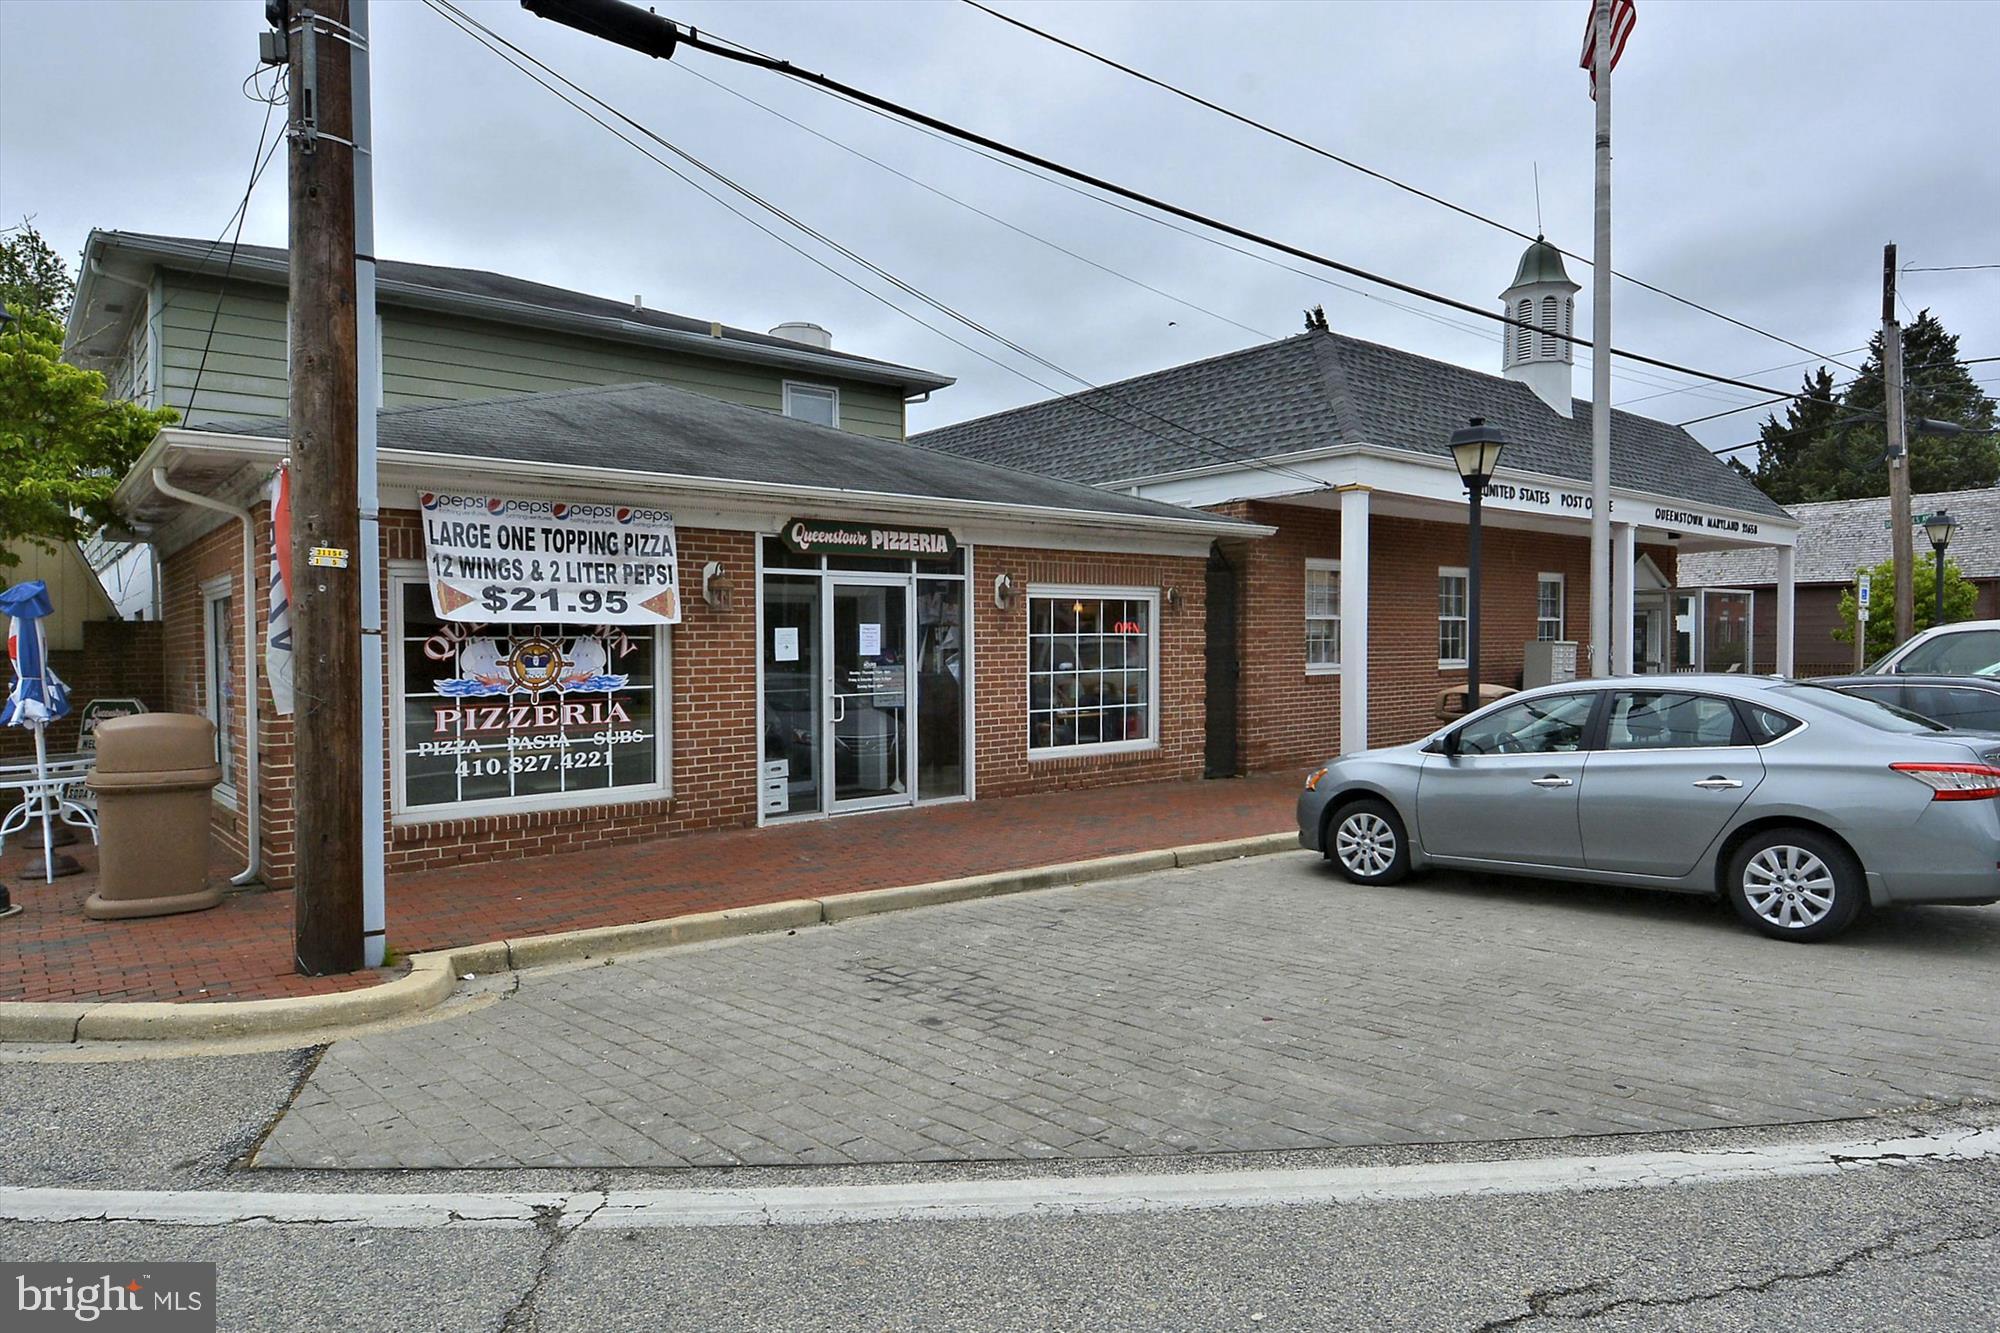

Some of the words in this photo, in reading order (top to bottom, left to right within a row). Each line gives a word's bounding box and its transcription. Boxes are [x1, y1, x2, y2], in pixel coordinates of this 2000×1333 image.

[439, 494, 487, 510] pepsi
[506, 499, 553, 514] pepsi
[1483, 482, 1516, 499] UNITED
[1519, 487, 1551, 505] STATES
[1561, 493, 1584, 508] POST
[570, 503, 615, 519] pepsi
[633, 508, 673, 523] pepsi
[1707, 516, 1740, 531] MARYLAND
[428, 519, 491, 549] LARGE
[497, 525, 535, 552] ONE
[541, 527, 619, 556] TOPPING
[624, 532, 673, 557] PIZZA
[791, 522, 868, 550] Queenstown
[870, 529, 948, 553] PIZZERIA
[432, 553, 453, 578] 12
[458, 555, 524, 581] WINGS
[531, 559, 544, 581] &
[549, 560, 560, 582] 2
[565, 561, 618, 584] LITER
[622, 563, 673, 585] PEPSI
[481, 585, 628, 614] $21.95
[1114, 621, 1140, 635] OPEN
[434, 701, 631, 733] PIZZERIA
[418, 738, 482, 757] PIZZA
[506, 734, 571, 751] PASTA
[593, 729, 645, 746] SUBS
[455, 750, 614, 778] 410.827.4221
